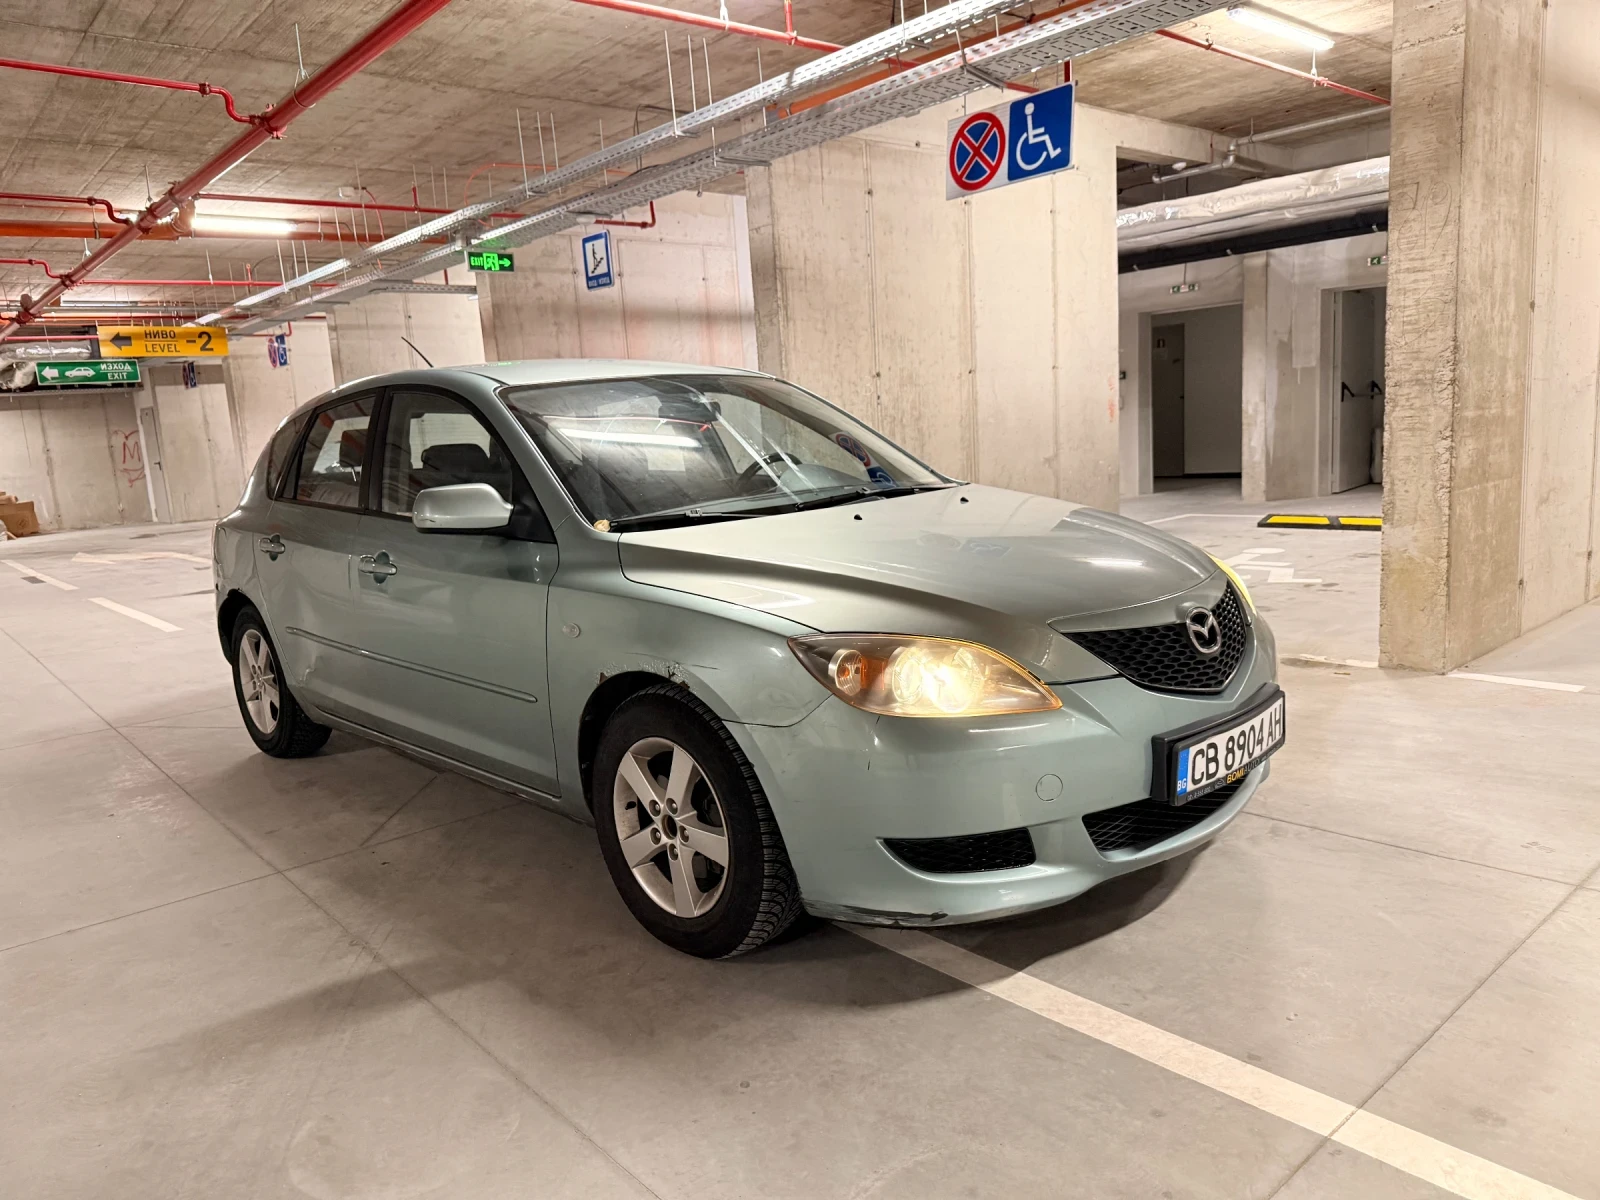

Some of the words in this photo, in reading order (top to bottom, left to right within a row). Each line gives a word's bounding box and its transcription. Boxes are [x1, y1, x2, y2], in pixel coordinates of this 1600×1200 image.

[470, 256, 483, 266] EXIT
[144, 330, 176, 339] НИВО
[186, 331, 214, 352] -2
[145, 343, 180, 353] LEVEL
[100, 362, 132, 371] ИЗХОД
[107, 372, 128, 380] EXIT
[1191, 742, 1219, 786] CB
[1224, 718, 1264, 771] 8904
[1266, 703, 1282, 747] AH
[1177, 778, 1187, 792] BG
